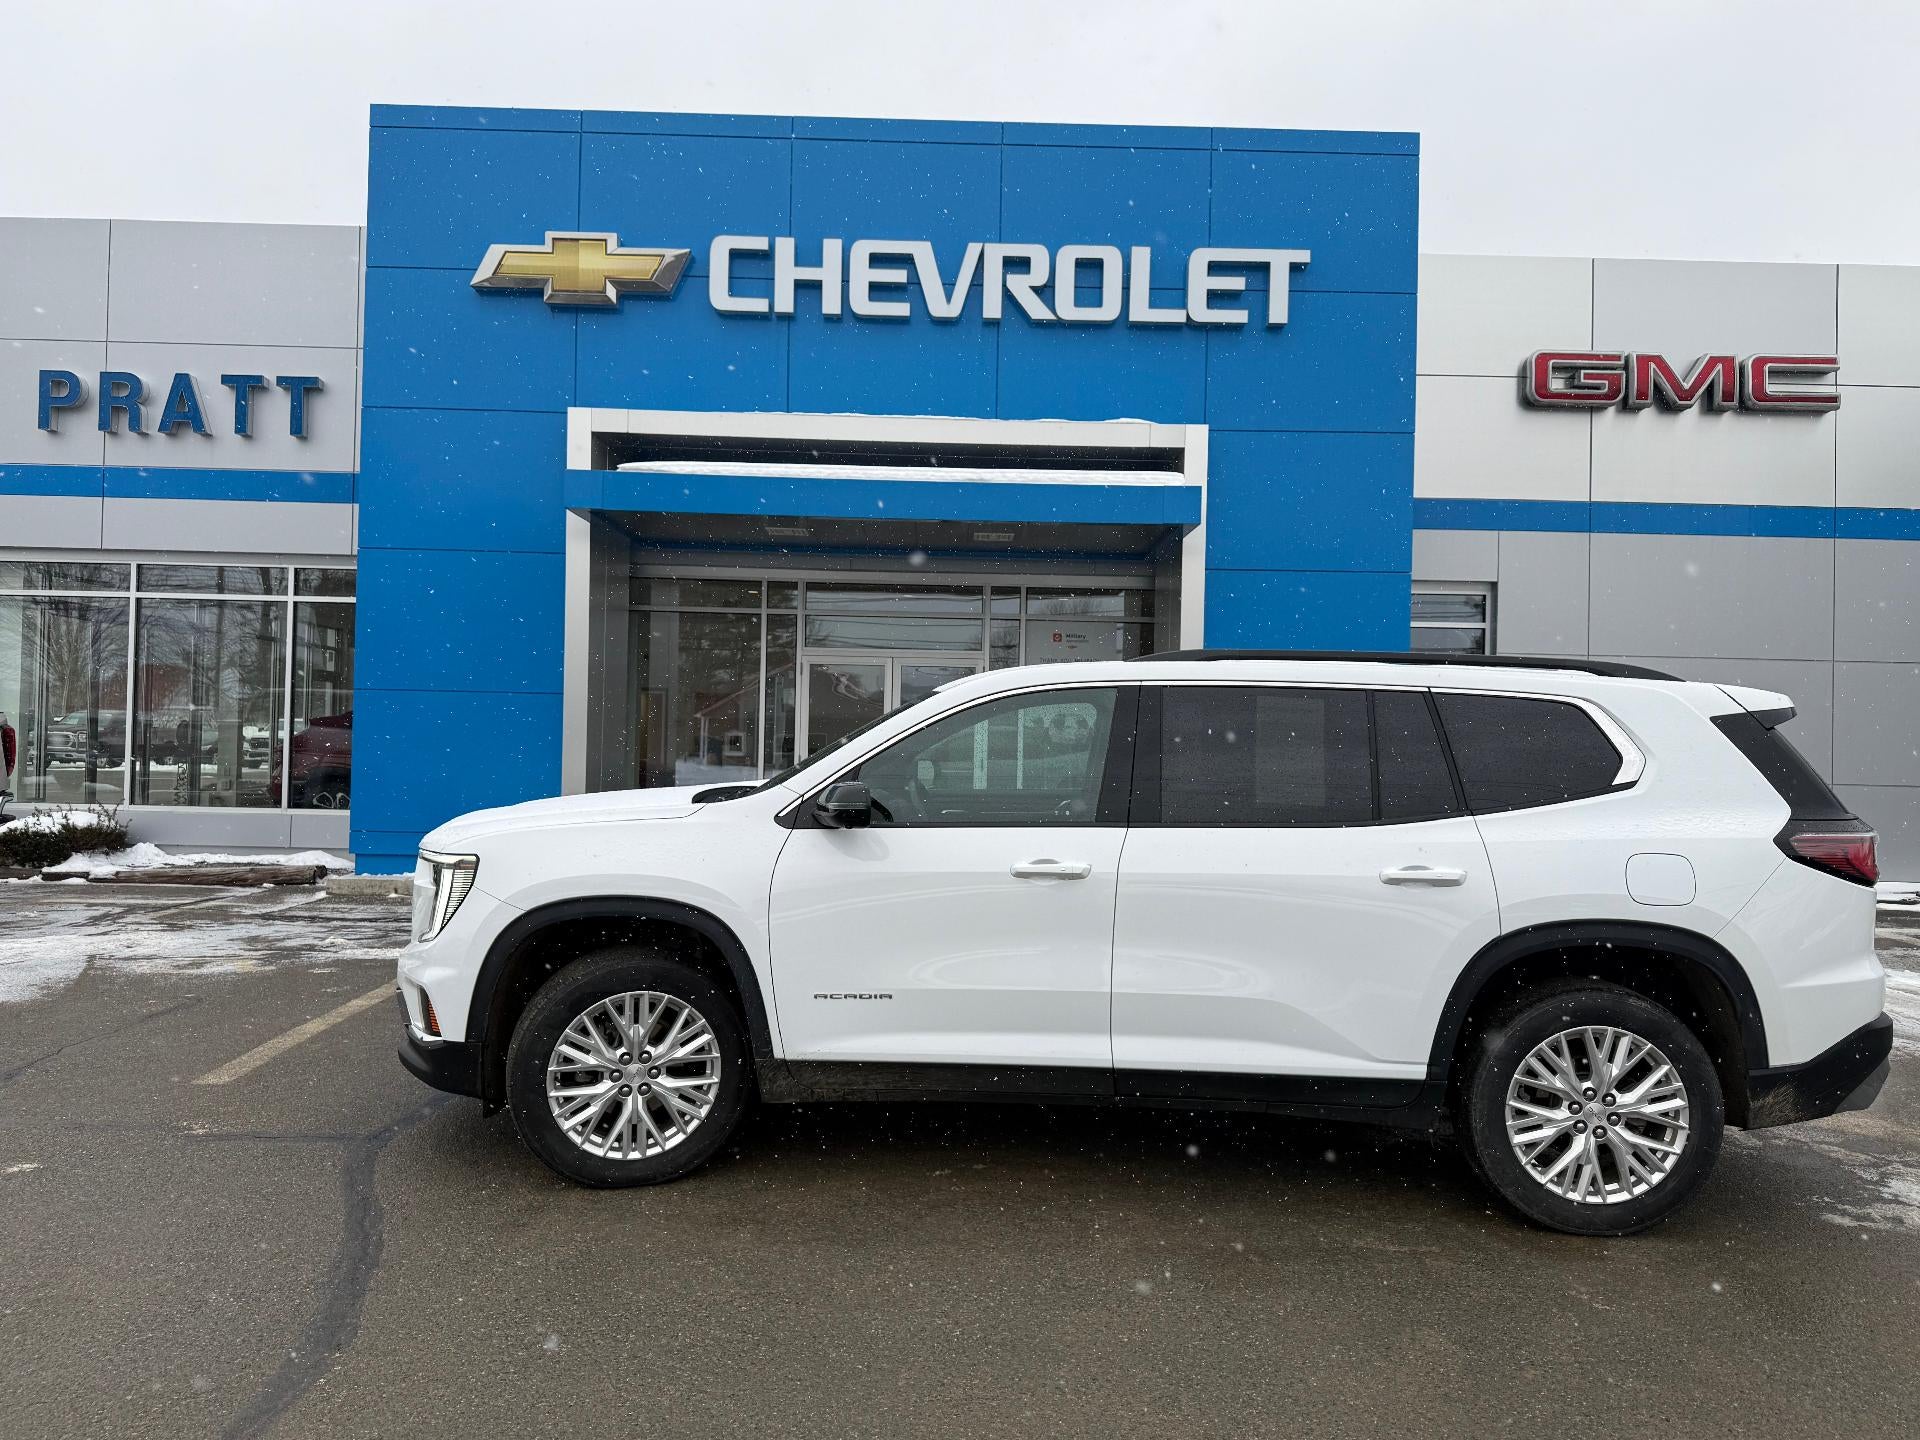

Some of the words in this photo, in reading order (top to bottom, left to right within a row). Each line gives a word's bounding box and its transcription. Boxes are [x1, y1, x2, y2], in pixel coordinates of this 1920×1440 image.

[709, 235, 1311, 325] CHEVROLET
[38, 369, 324, 438] PRATT
[1525, 350, 1841, 412] GMC
